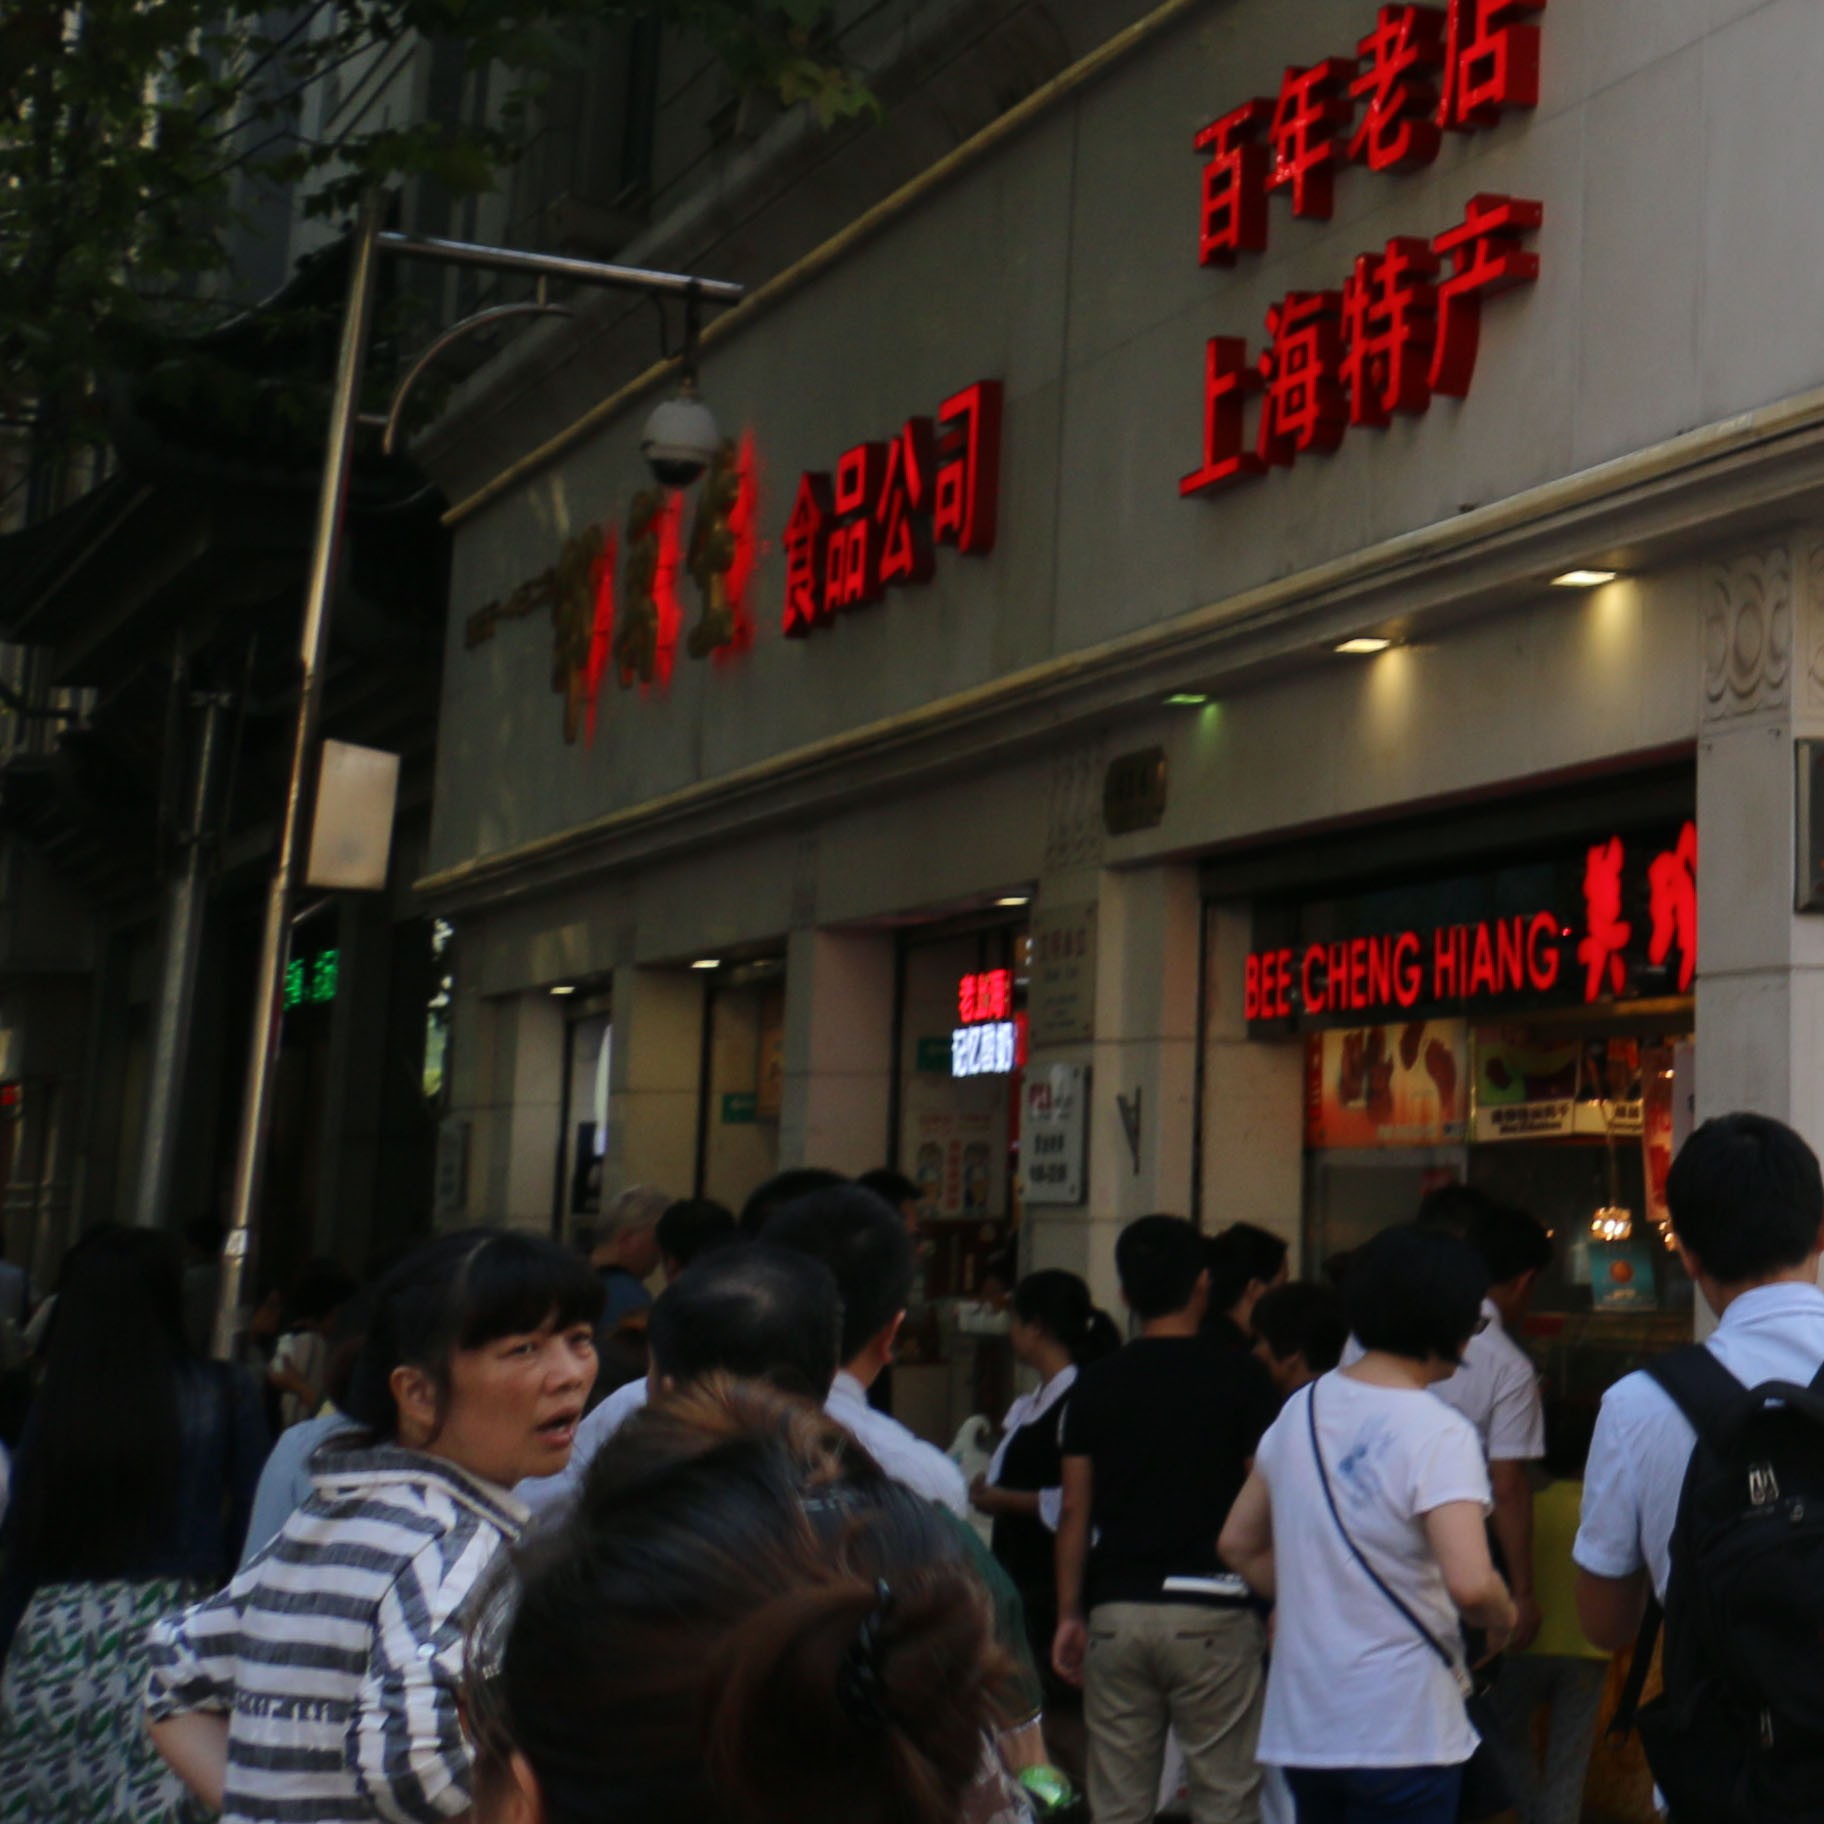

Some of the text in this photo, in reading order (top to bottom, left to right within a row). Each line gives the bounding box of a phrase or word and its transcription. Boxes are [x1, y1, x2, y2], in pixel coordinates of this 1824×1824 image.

[1179, 193, 1543, 497] 上海特产
[782, 379, 1004, 639] 食品公司
[1244, 947, 1293, 1020] BEE
[1301, 929, 1423, 1013] CHENG
[1432, 912, 1560, 1000] HIANG
